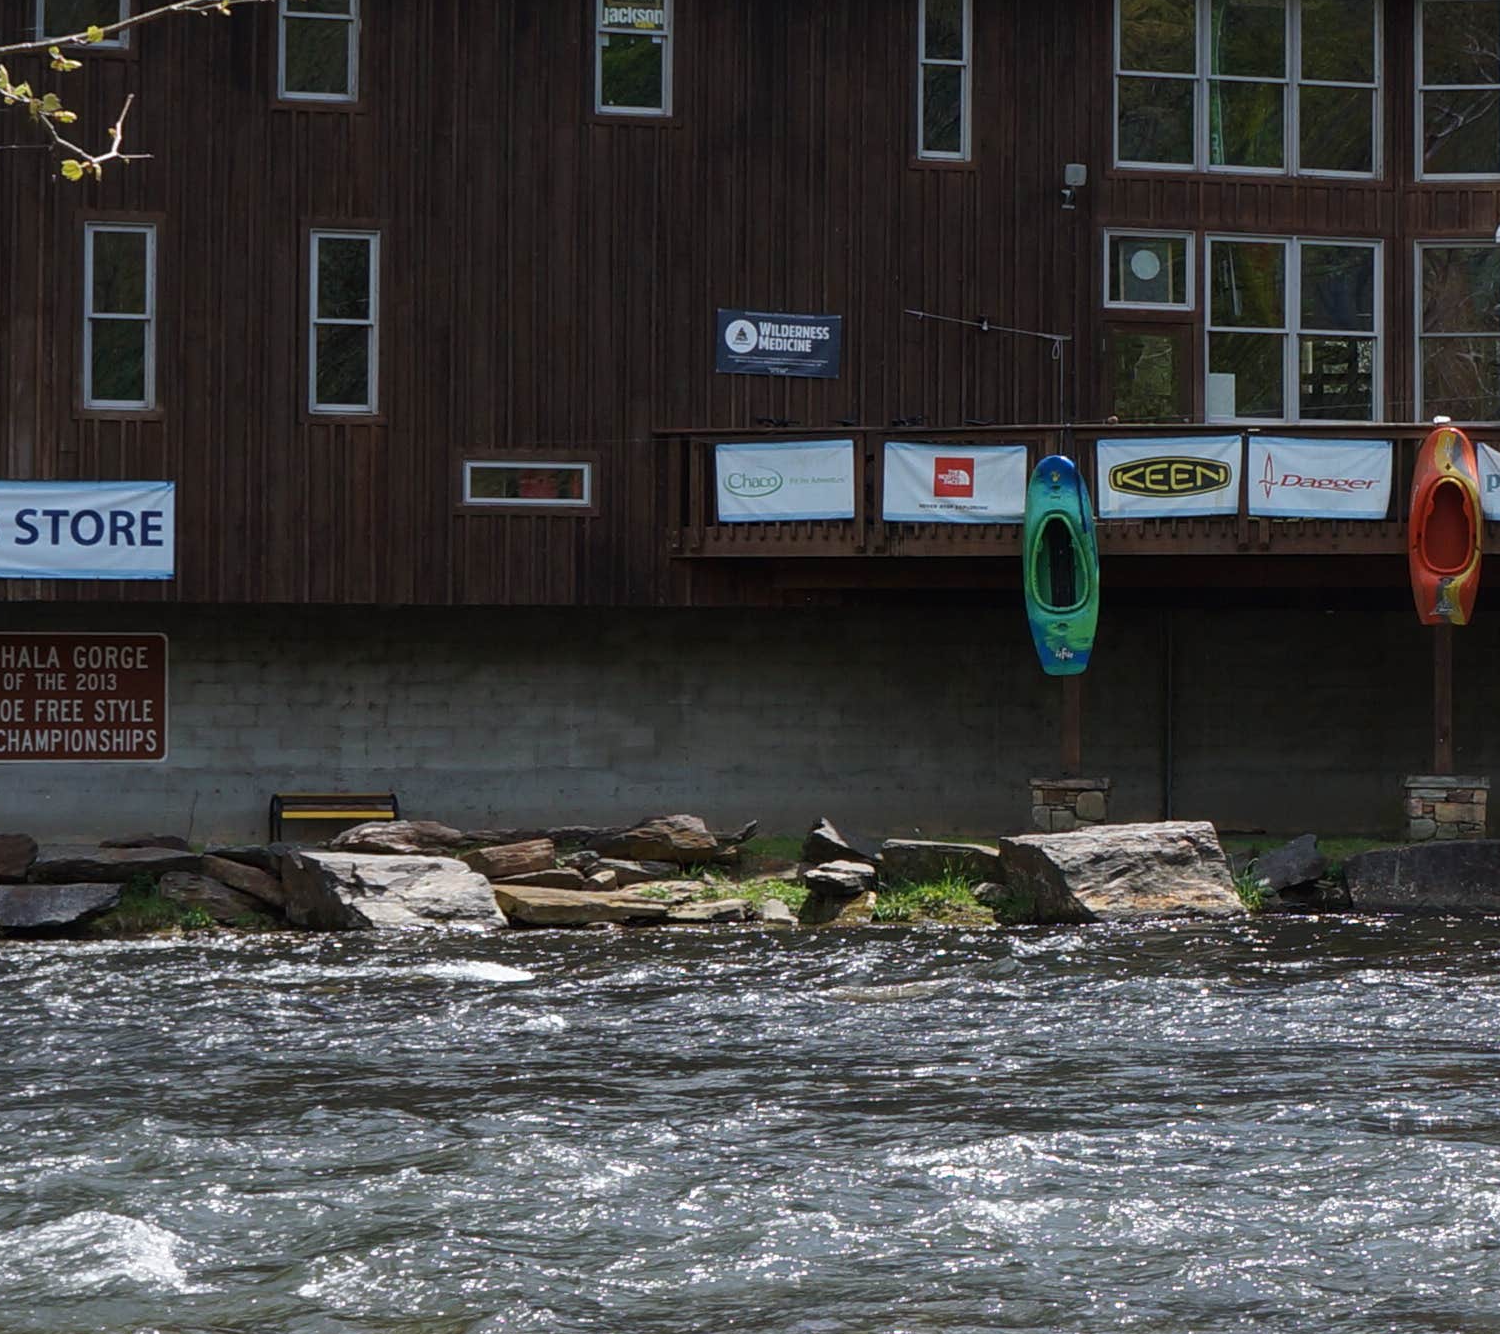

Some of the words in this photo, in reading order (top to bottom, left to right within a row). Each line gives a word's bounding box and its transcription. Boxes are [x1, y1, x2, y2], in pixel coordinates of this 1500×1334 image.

[758, 322, 830, 340] WILDERNESS
[758, 336, 812, 353] MEDICINE
[727, 472, 778, 489] Chaco
[1116, 463, 1225, 491] KEEN
[1280, 473, 1381, 493] Dagger
[14, 508, 164, 547] STORE
[73, 646, 149, 669] GORGE
[3, 673, 26, 691] OF
[35, 673, 67, 691] THE
[76, 673, 118, 691] 2013
[34, 699, 84, 723] FREE
[94, 699, 154, 723] STYLE
